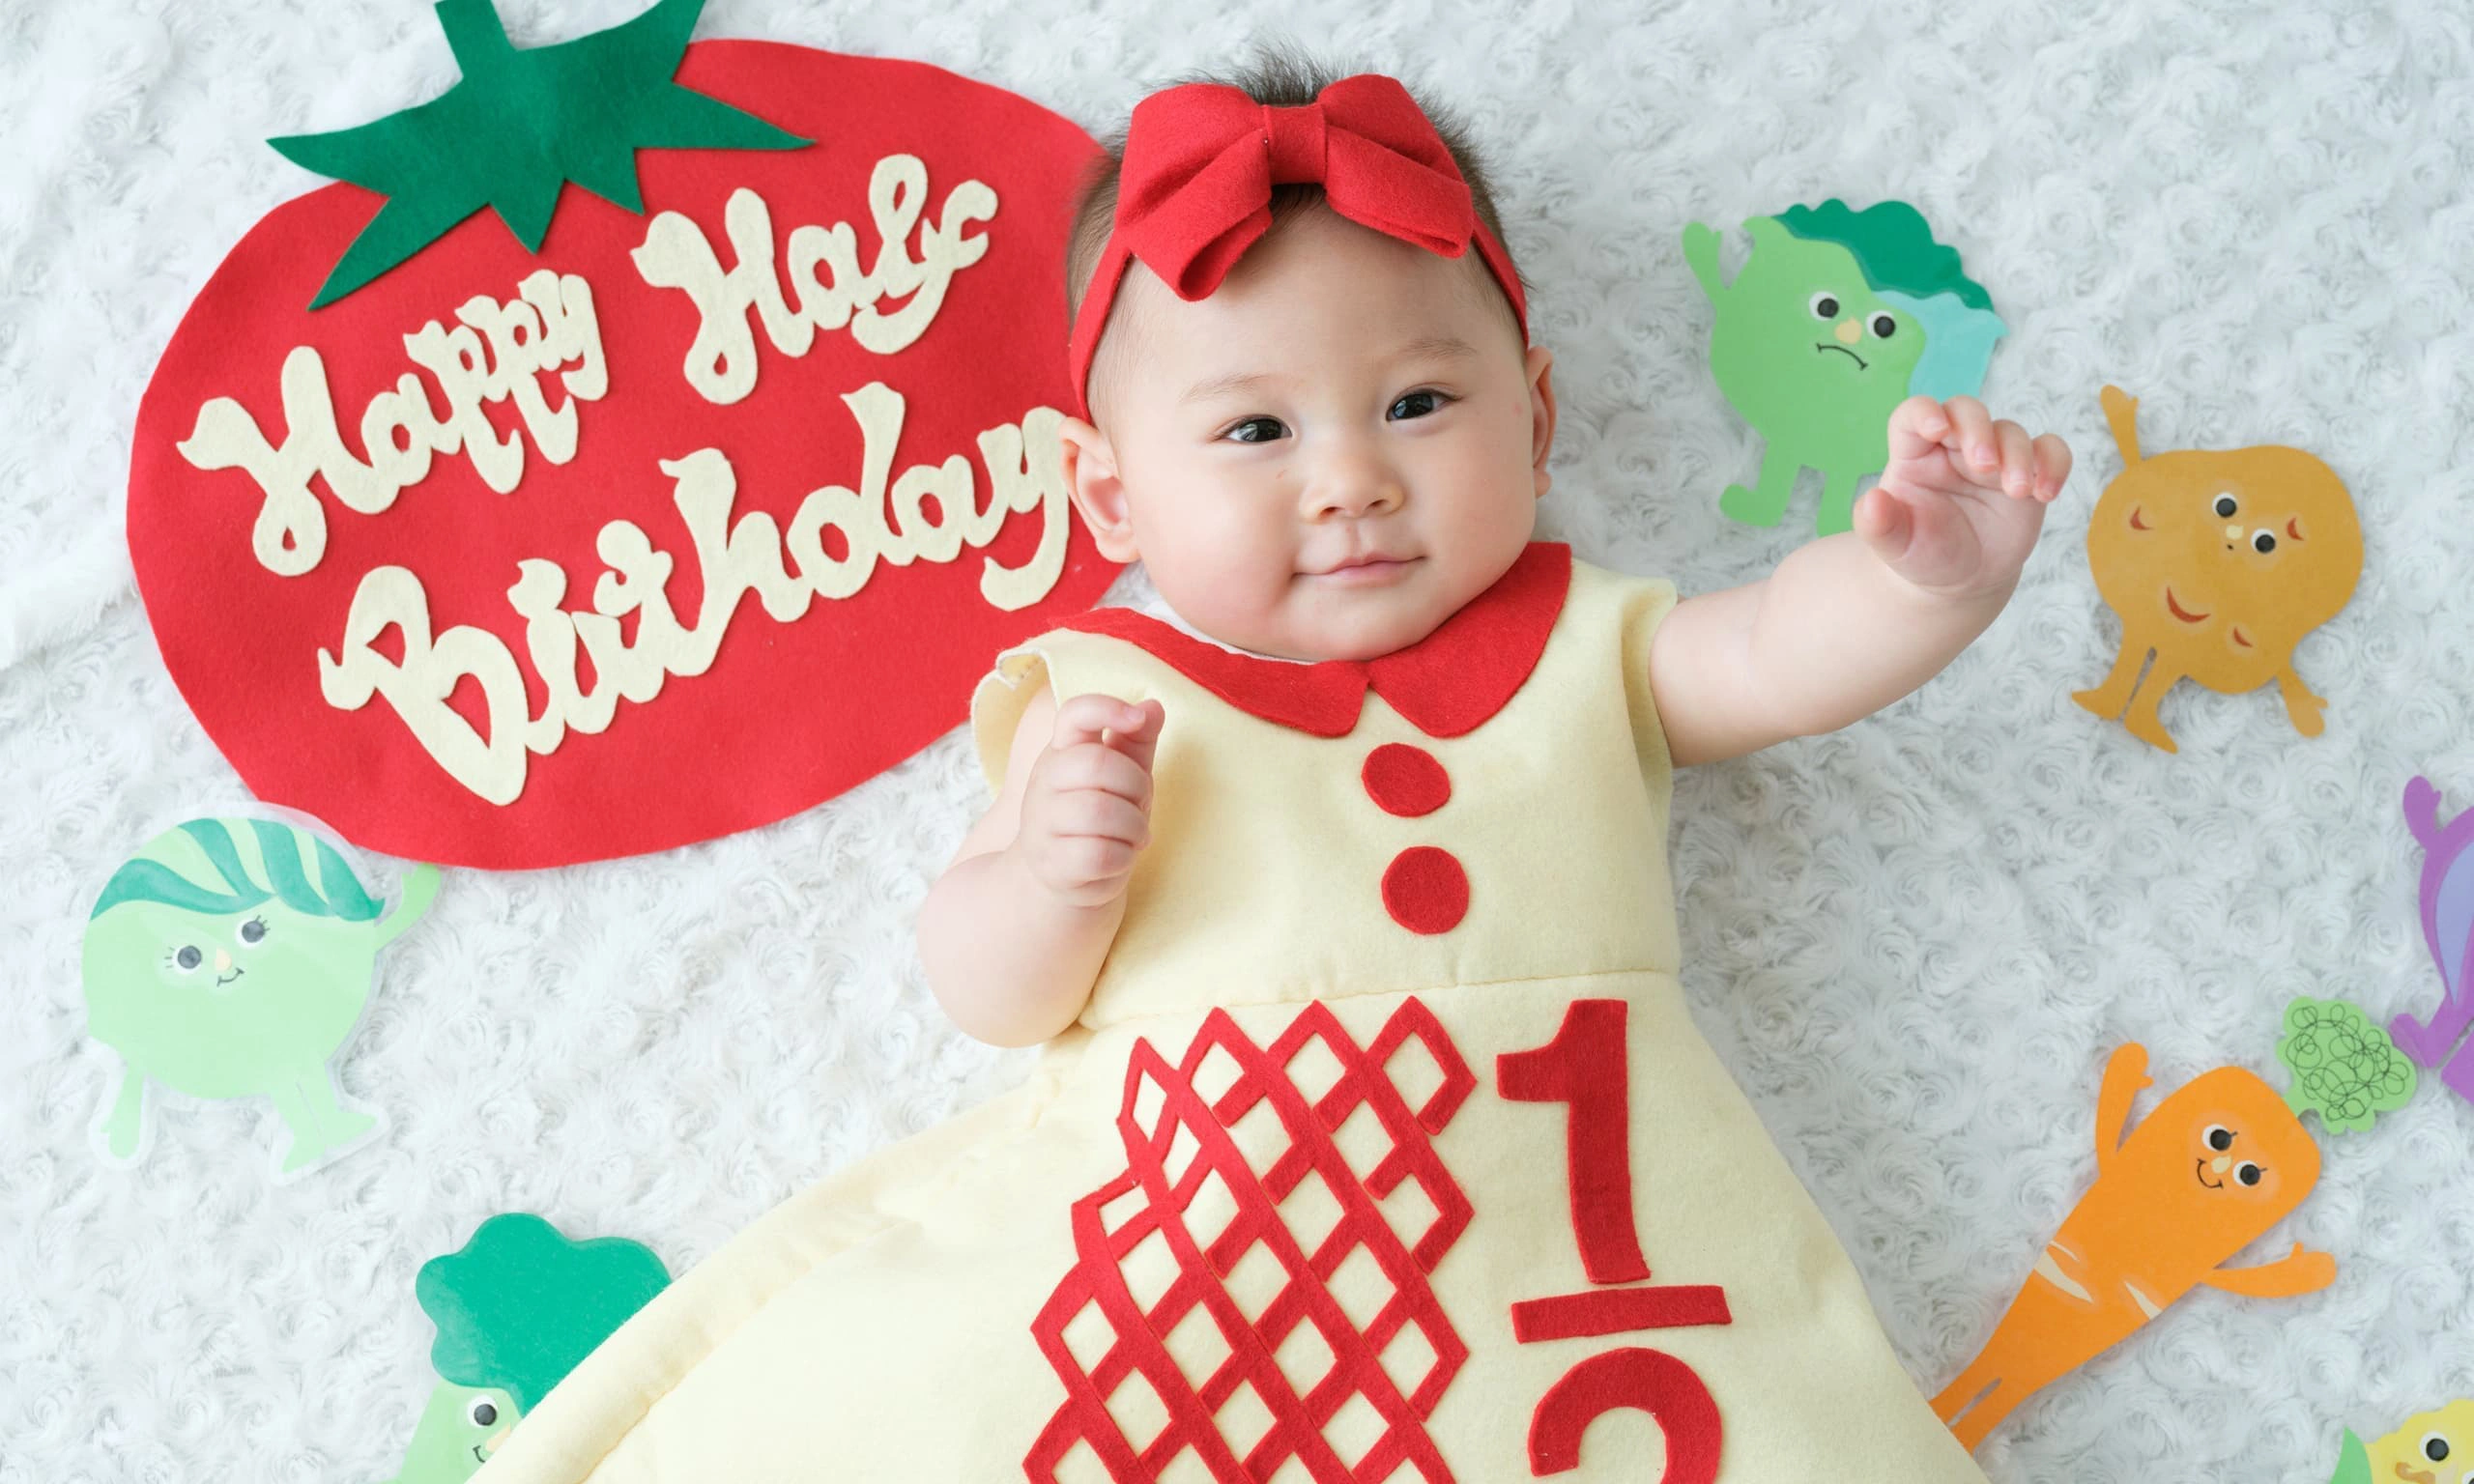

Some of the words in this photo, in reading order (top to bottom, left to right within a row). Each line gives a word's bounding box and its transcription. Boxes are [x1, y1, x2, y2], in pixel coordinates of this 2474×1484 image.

[176, 269, 609, 577] Happy
[630, 154, 998, 405] Half
[323, 382, 1070, 806] Birthday
[1497, 999, 1652, 1284] 1
